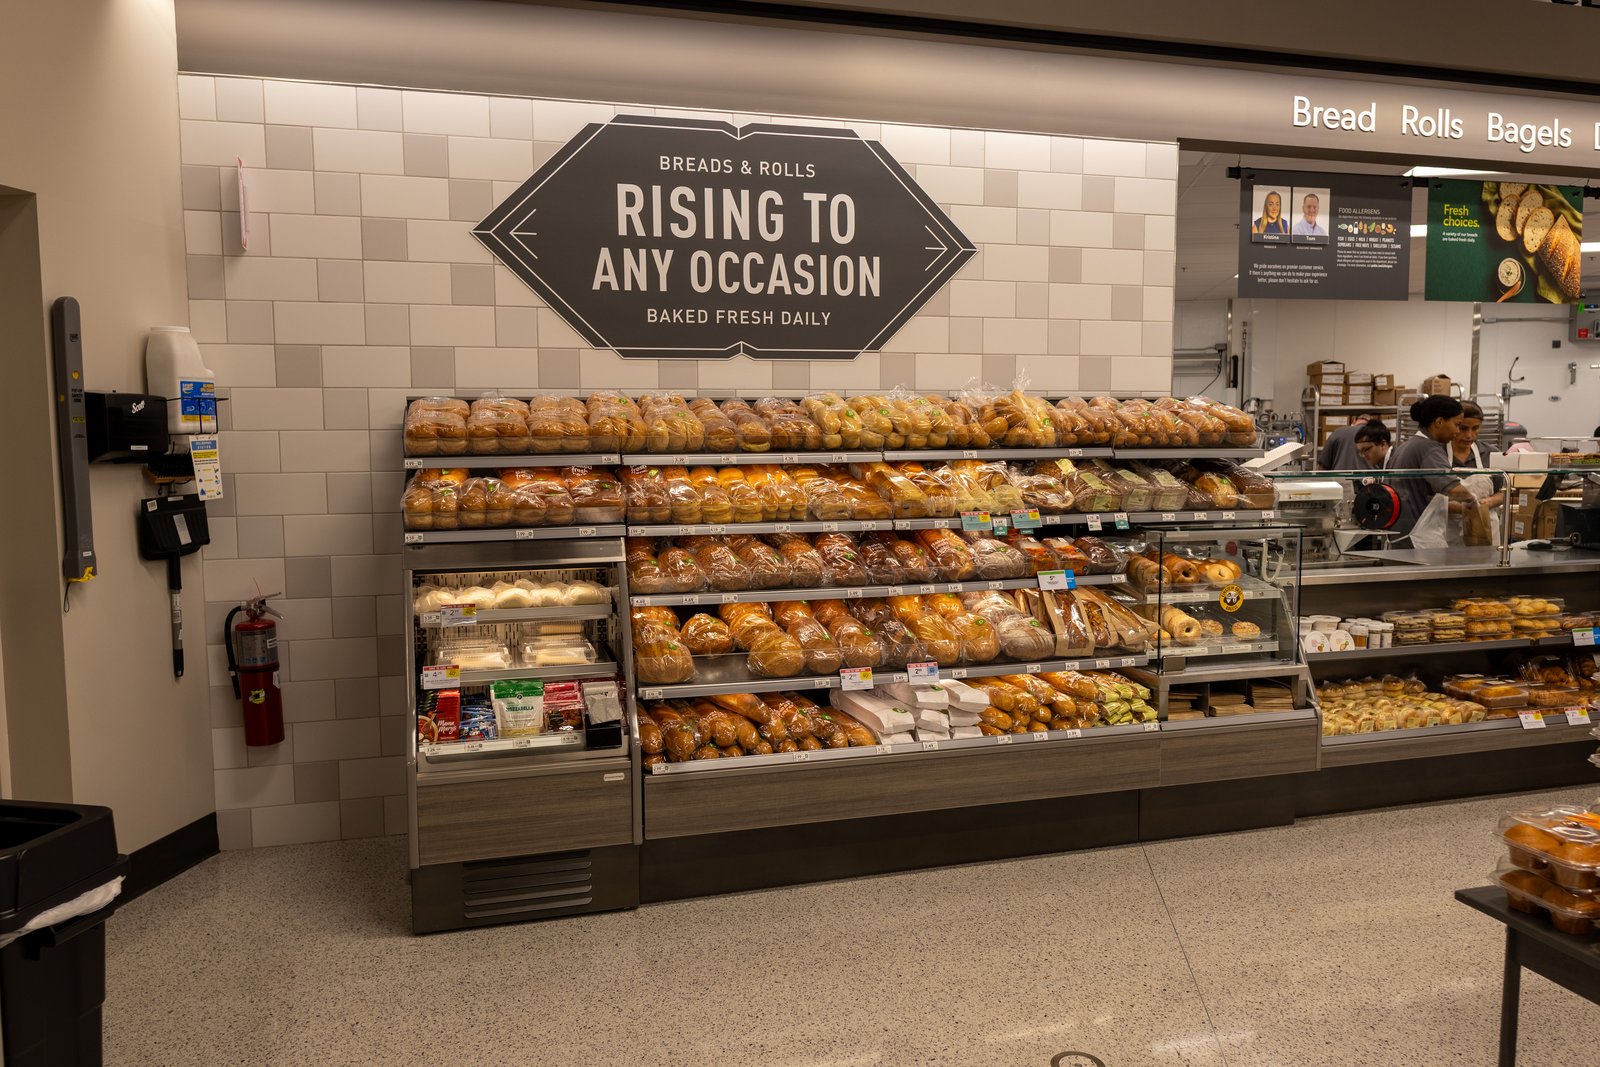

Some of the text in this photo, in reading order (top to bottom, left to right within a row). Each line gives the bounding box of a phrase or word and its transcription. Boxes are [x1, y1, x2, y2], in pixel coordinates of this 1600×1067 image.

[1293, 95, 1376, 132] Bread
[1401, 104, 1464, 139] Rolls
[1487, 112, 1572, 153] Bagels
[659, 155, 816, 178] BREADS & ROLLS
[617, 183, 856, 245] RISING TO
[1443, 204, 1469, 216] Fresh
[1443, 216, 1480, 228] choices.
[592, 247, 881, 297] ANY OCCASION
[647, 308, 831, 326] BAKED FRESH DAILY
